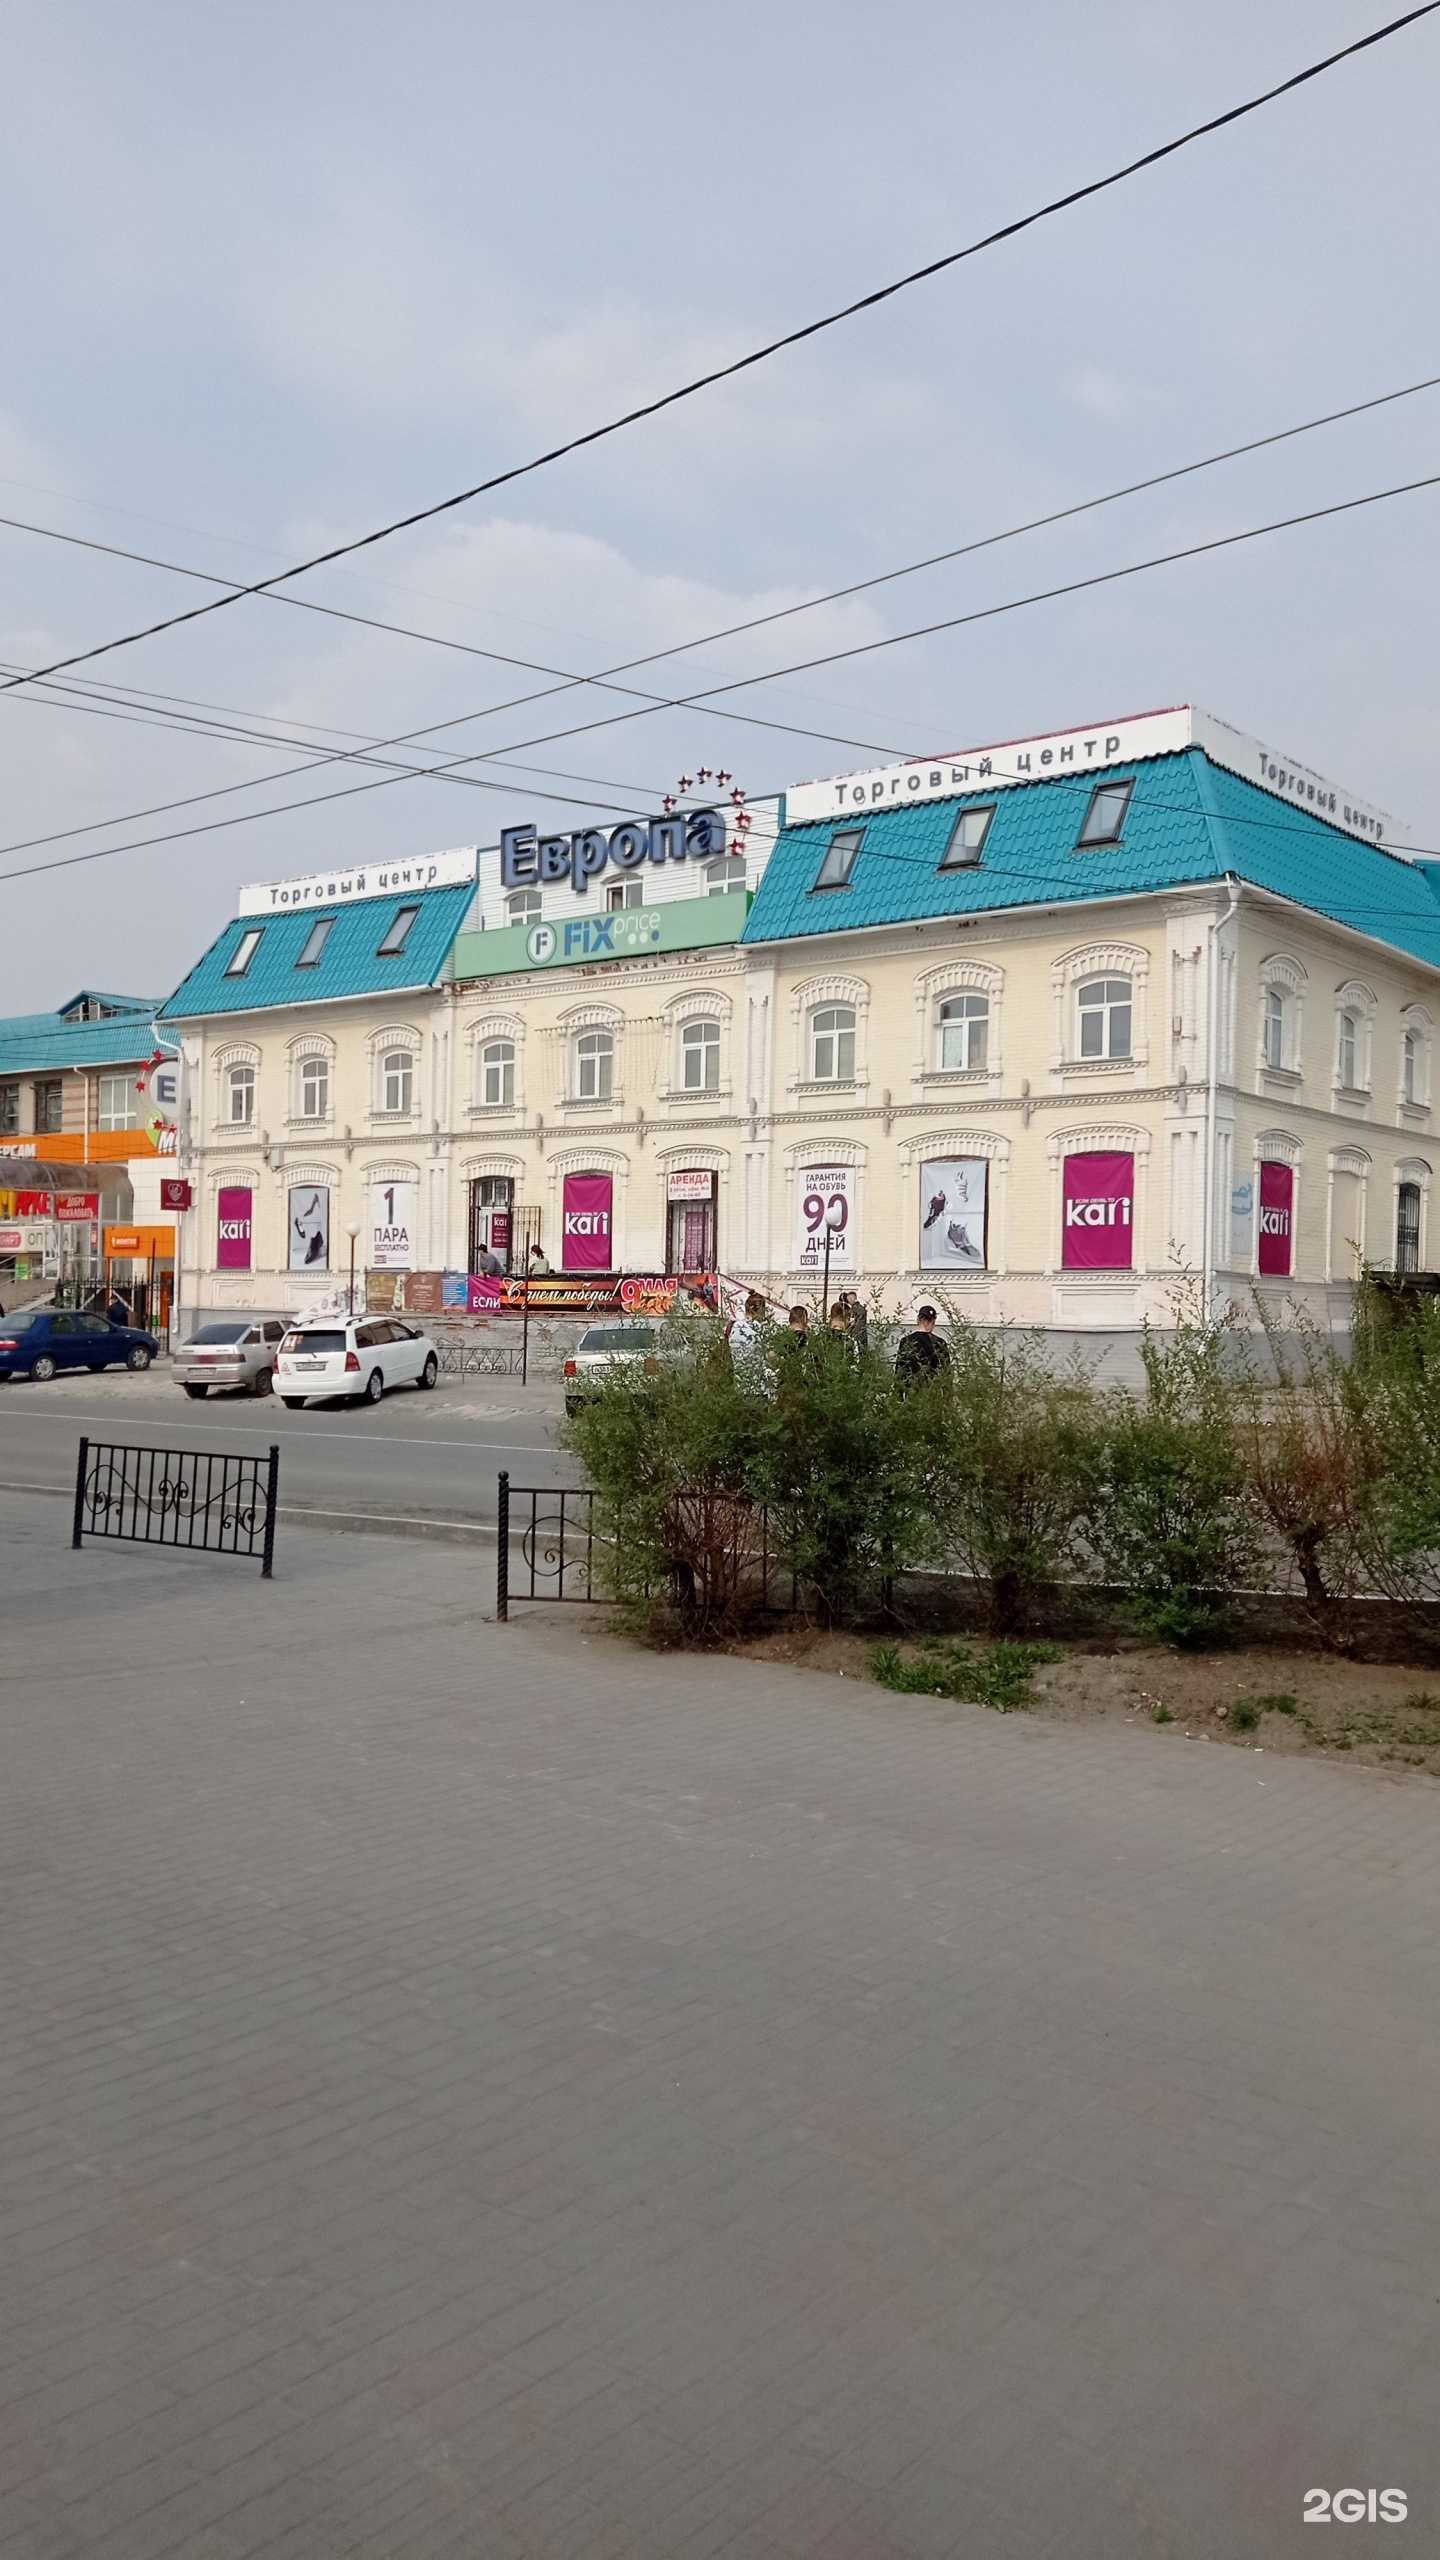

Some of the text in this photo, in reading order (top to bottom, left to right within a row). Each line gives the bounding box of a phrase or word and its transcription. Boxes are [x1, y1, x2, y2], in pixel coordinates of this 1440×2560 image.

[835, 735, 1120, 805] Торговый центр
[1259, 752, 1384, 841] Торговый центр
[501, 809, 727, 892] Европа
[270, 865, 437, 905] Торговый центр
[612, 911, 662, 936] price
[670, 1174, 709, 1185] АРЕНДА
[806, 1173, 846, 1183] ГАРАНТИЯ
[806, 1183, 846, 1192] НА ОБУВЬ
[384, 1187, 394, 1224] 1
[803, 1193, 848, 1233] 90
[1067, 1197, 1130, 1226] kari
[219, 1219, 252, 1239] kari
[374, 1227, 408, 1242] ПАРА
[565, 1211, 608, 1234] kari
[1260, 1206, 1289, 1235] kari
[806, 1234, 846, 1253] ДНЕЙ
[620, 1278, 678, 1313] 9 МАЯ
